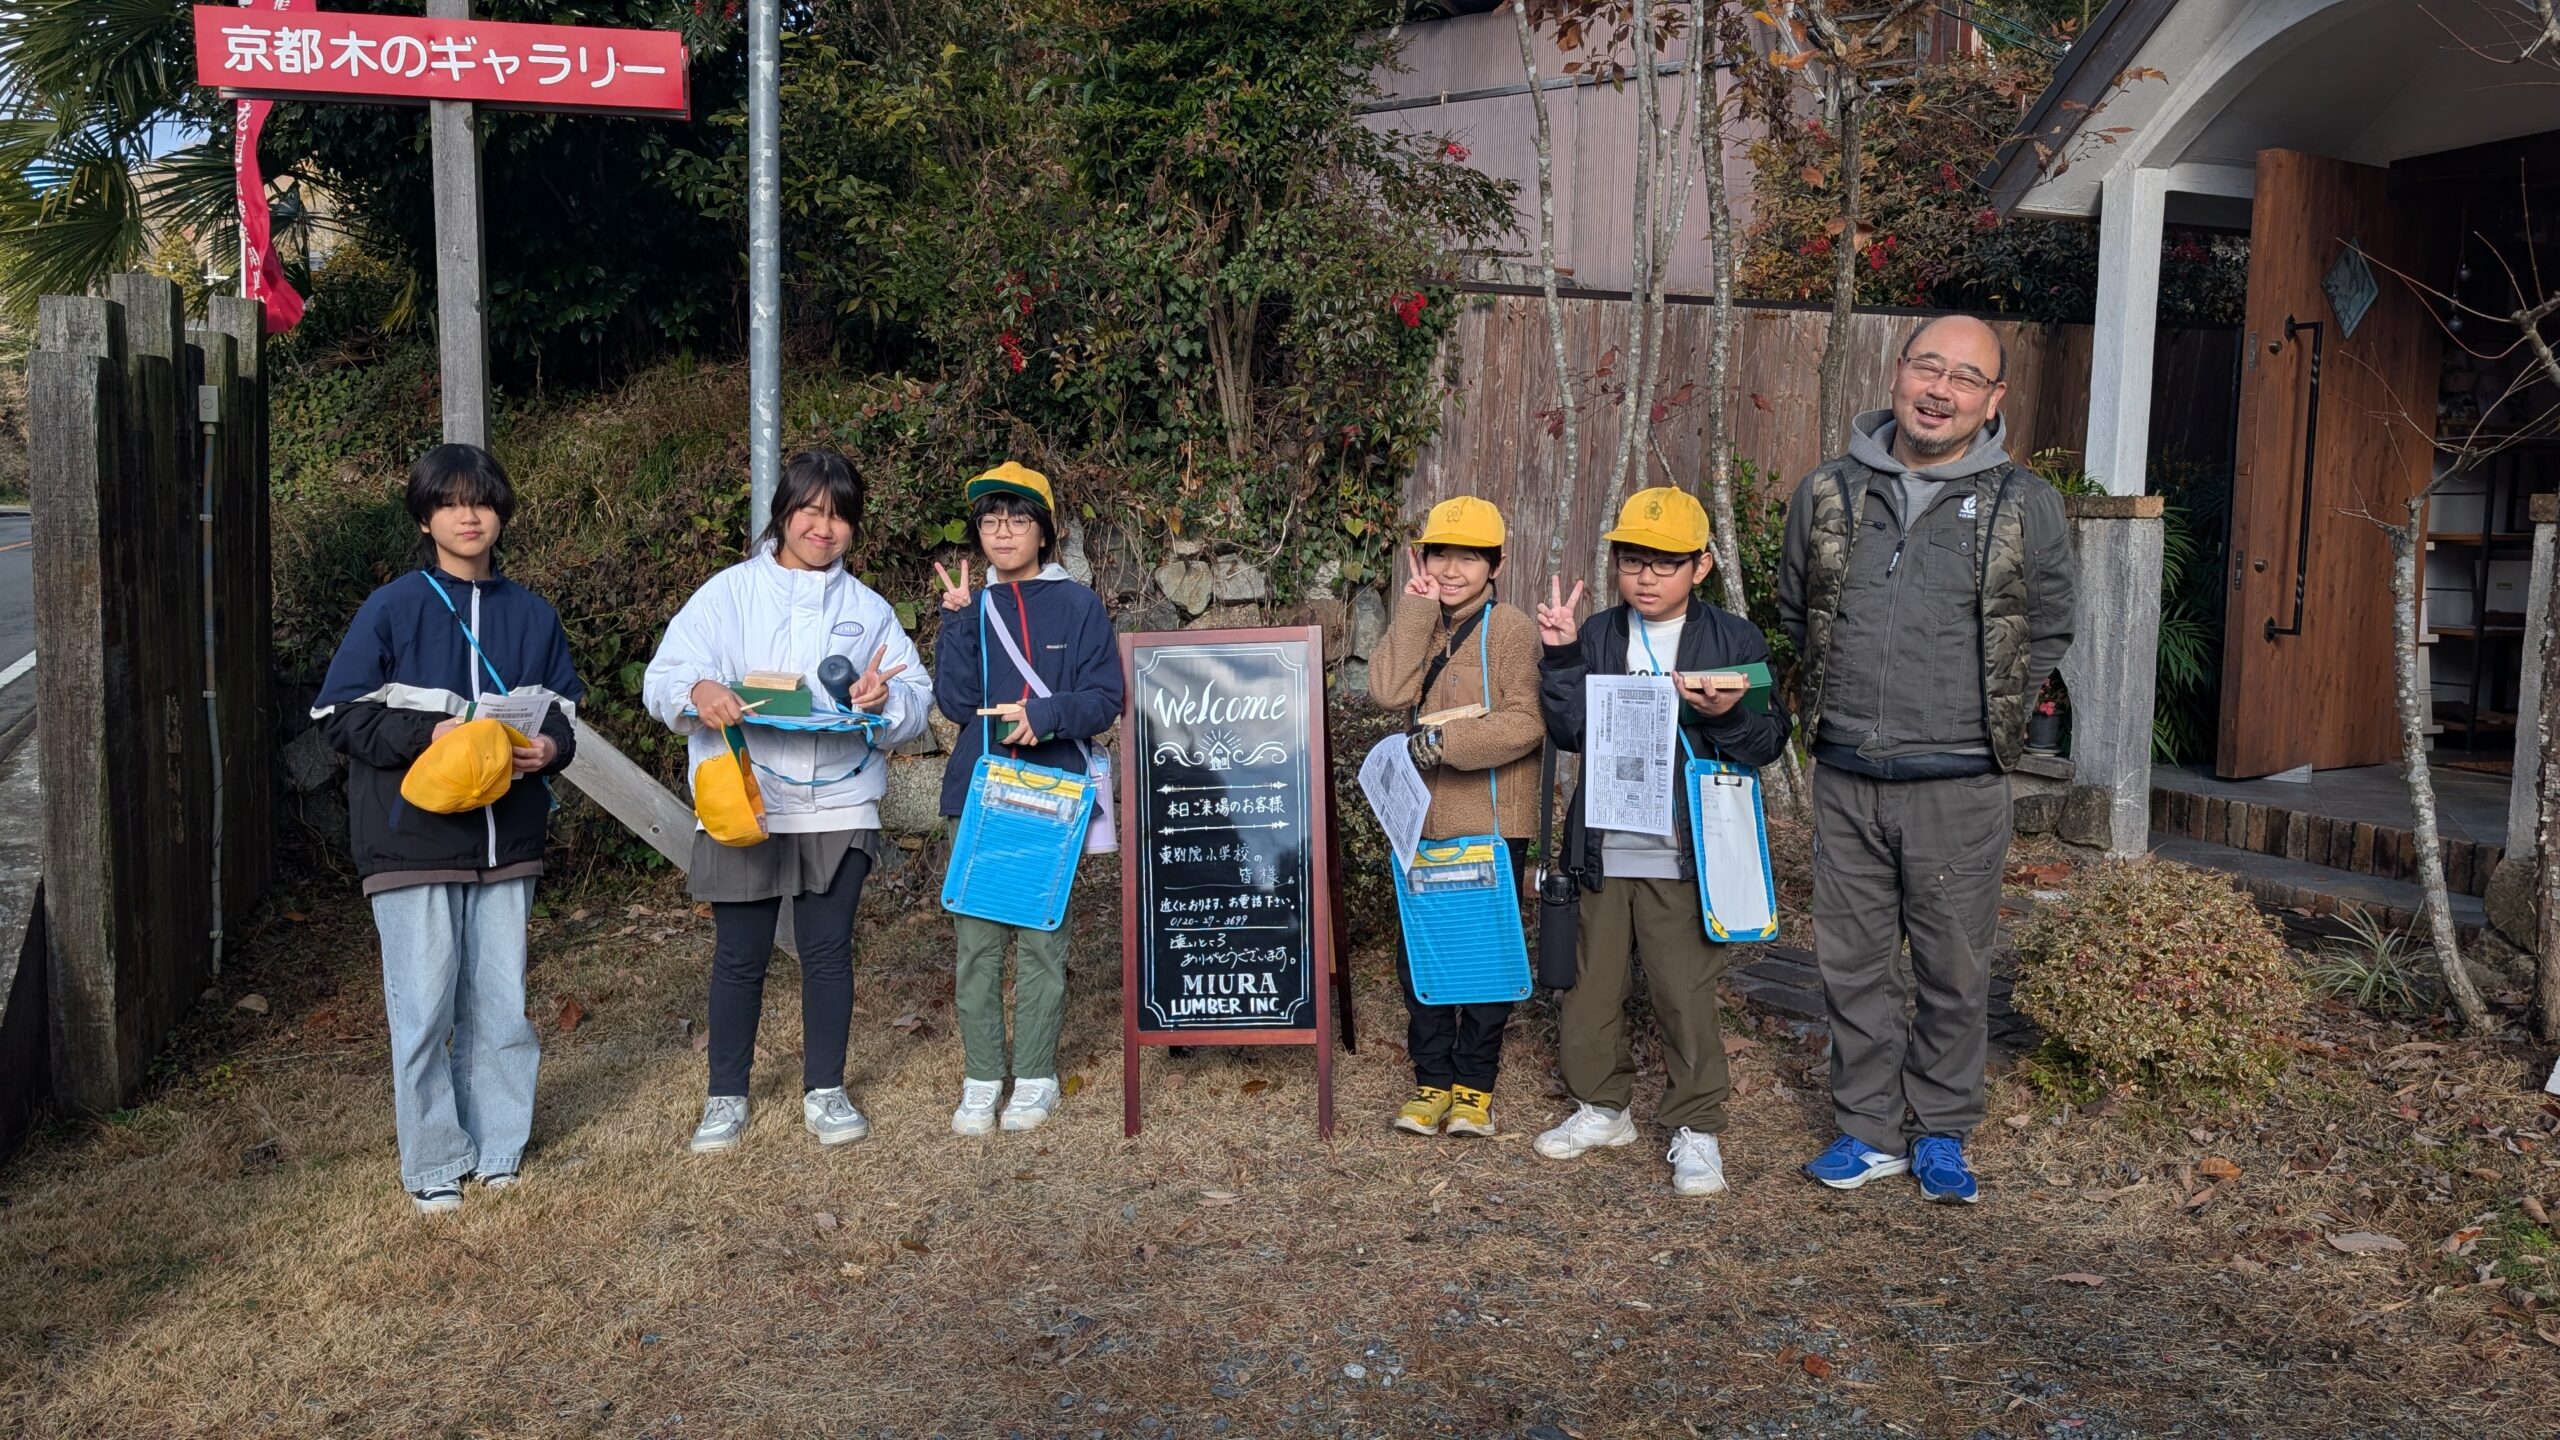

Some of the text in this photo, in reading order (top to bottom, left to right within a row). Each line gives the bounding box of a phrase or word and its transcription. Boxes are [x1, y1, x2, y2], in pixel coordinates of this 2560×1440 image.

[1154, 679, 1286, 728] Welcome
[1167, 795, 1285, 818] 本日ご来場のお客様
[1159, 843, 1262, 864] 東別院小学校の
[1182, 972, 1278, 996] MIURA
[1171, 997, 1285, 1016] LUMBER INC.
